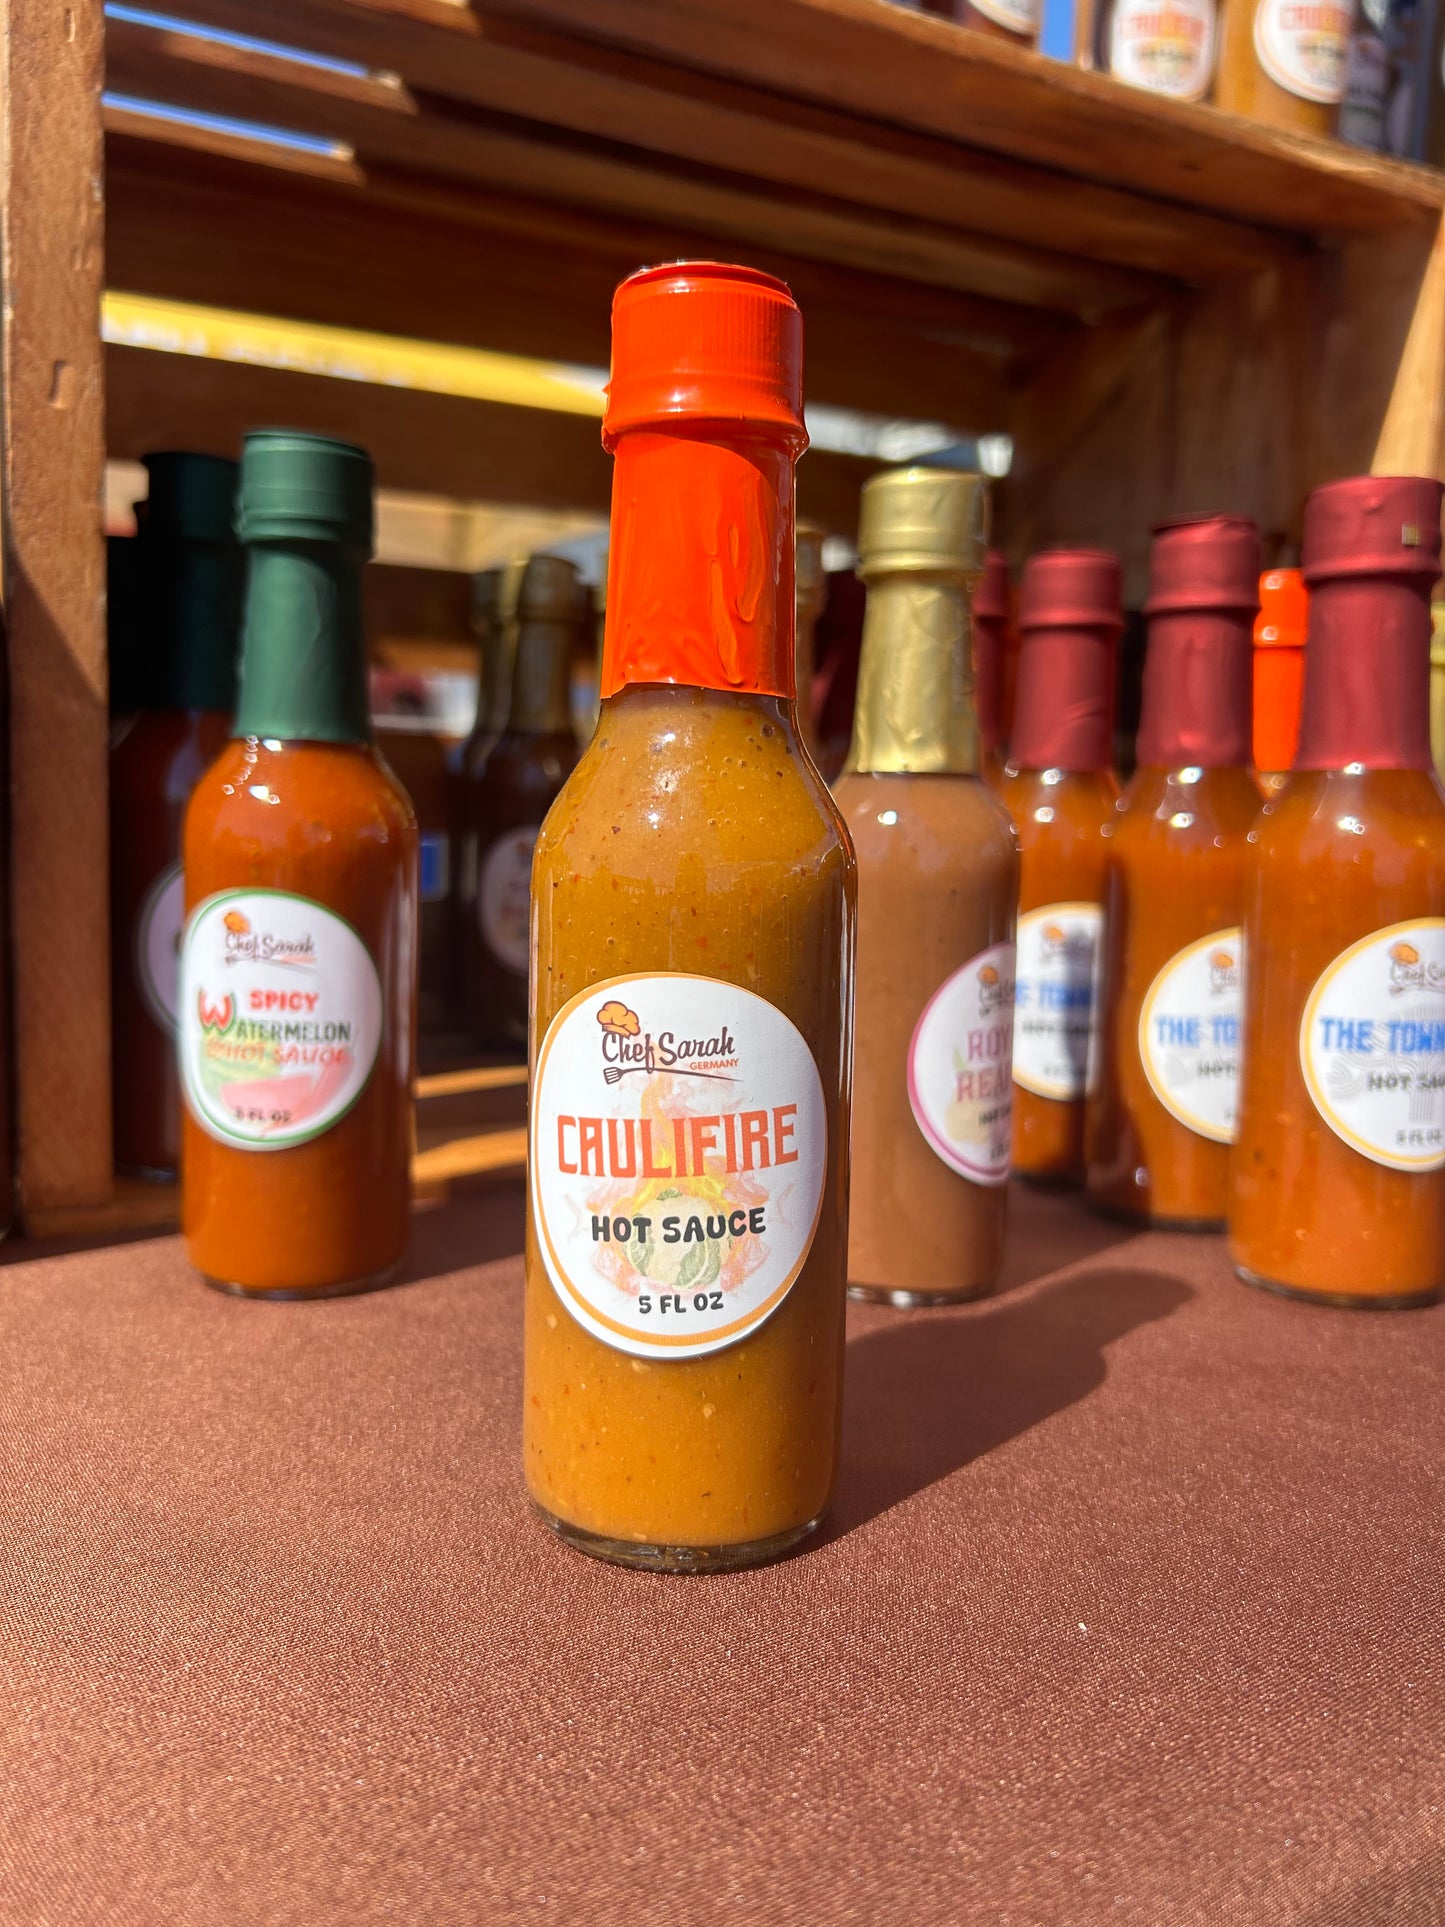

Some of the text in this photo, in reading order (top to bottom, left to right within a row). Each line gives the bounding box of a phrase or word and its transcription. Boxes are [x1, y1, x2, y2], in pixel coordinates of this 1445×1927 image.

[249, 989, 319, 1012] SPICY
[1156, 1015, 1200, 1047] THE
[1320, 1017, 1375, 1053] THE
[602, 1026, 736, 1074] Chef Sarah
[689, 1058, 740, 1071] GERMANY
[1366, 1073, 1411, 1092] HOT
[557, 1103, 799, 1179] CAULIFIRE
[591, 1206, 767, 1244] HOT SAUCE
[638, 1291, 725, 1315] 5 FL OZ
